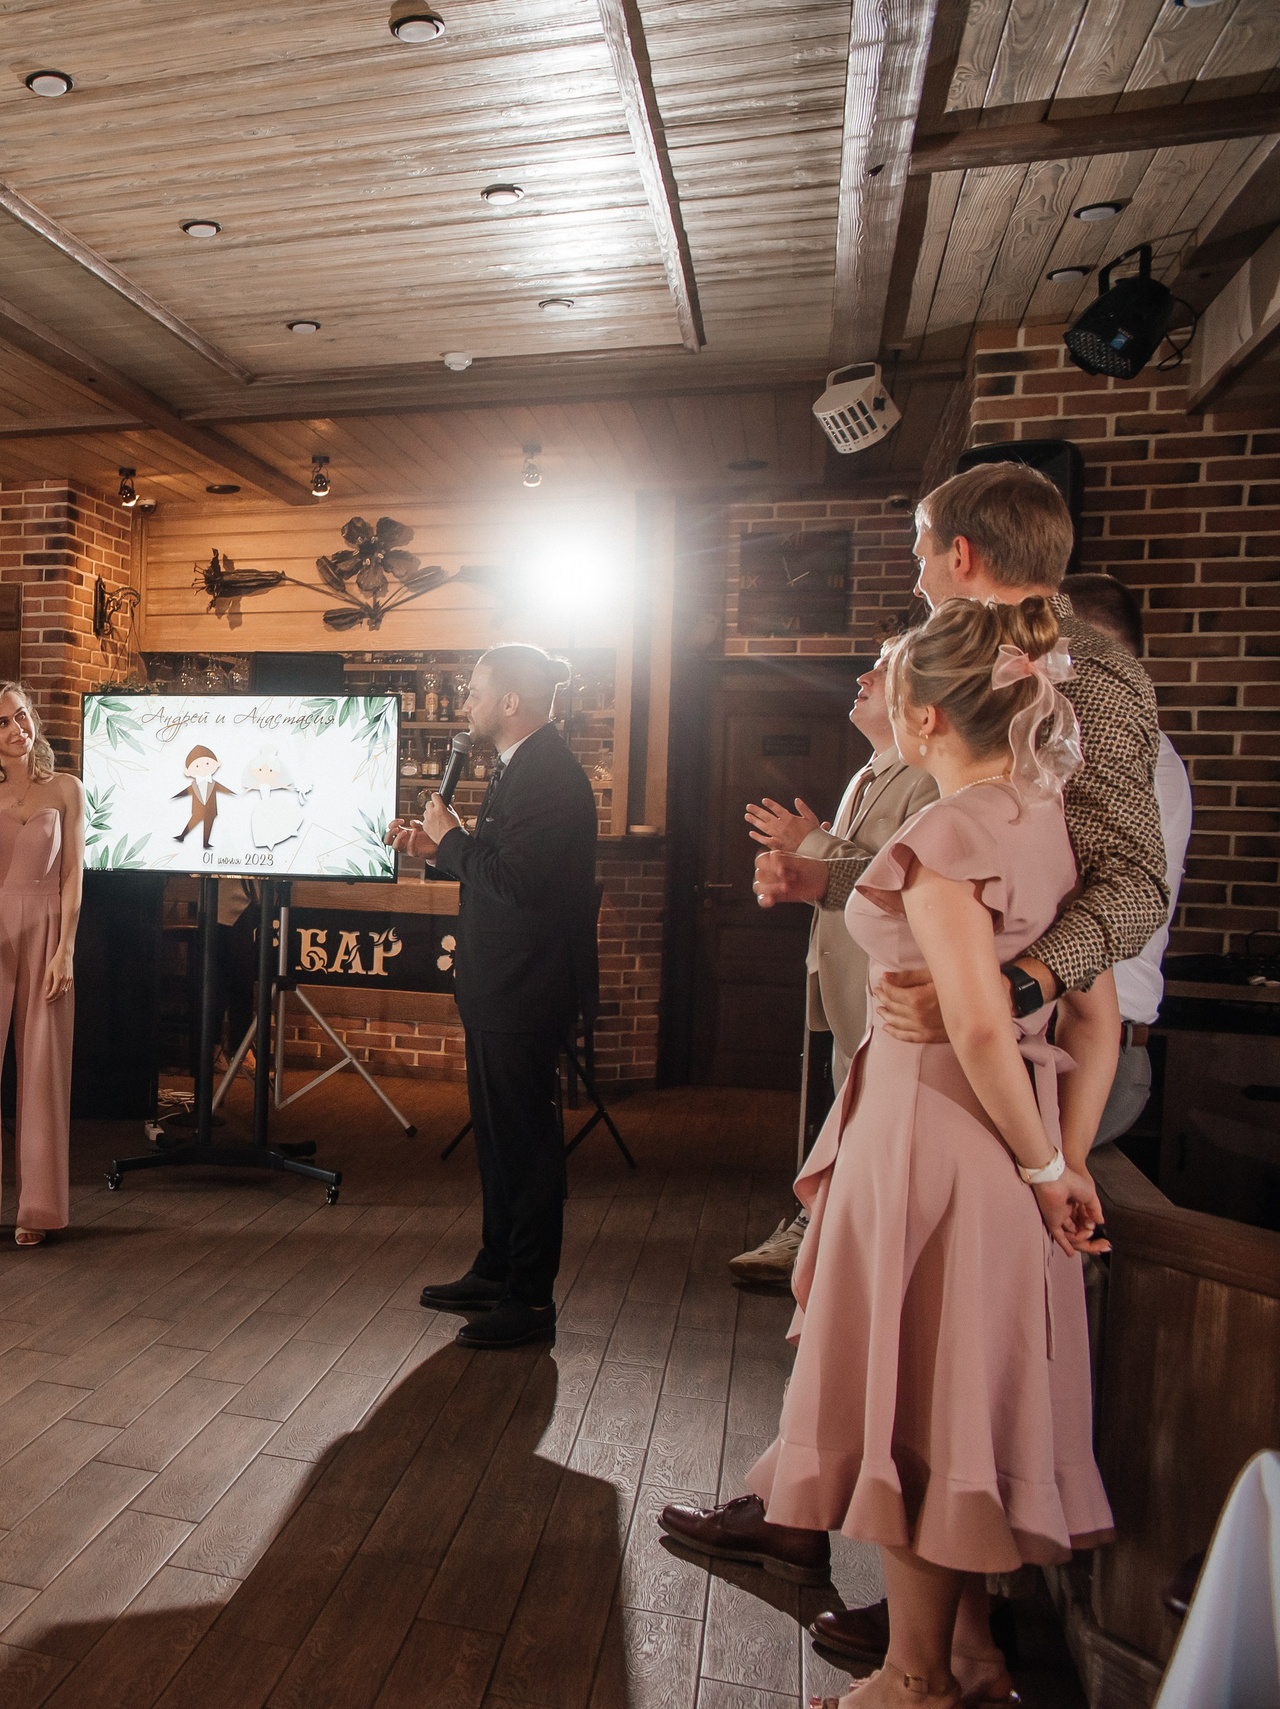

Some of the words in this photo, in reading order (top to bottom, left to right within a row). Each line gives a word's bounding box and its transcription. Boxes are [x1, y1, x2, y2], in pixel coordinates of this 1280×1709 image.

[141, 706, 210, 743] Андрей
[215, 714, 226, 724] и
[233, 706, 336, 730] Анастасия
[202, 851, 214, 865] 01
[244, 853, 274, 867] 2023
[295, 926, 403, 976] БАР
